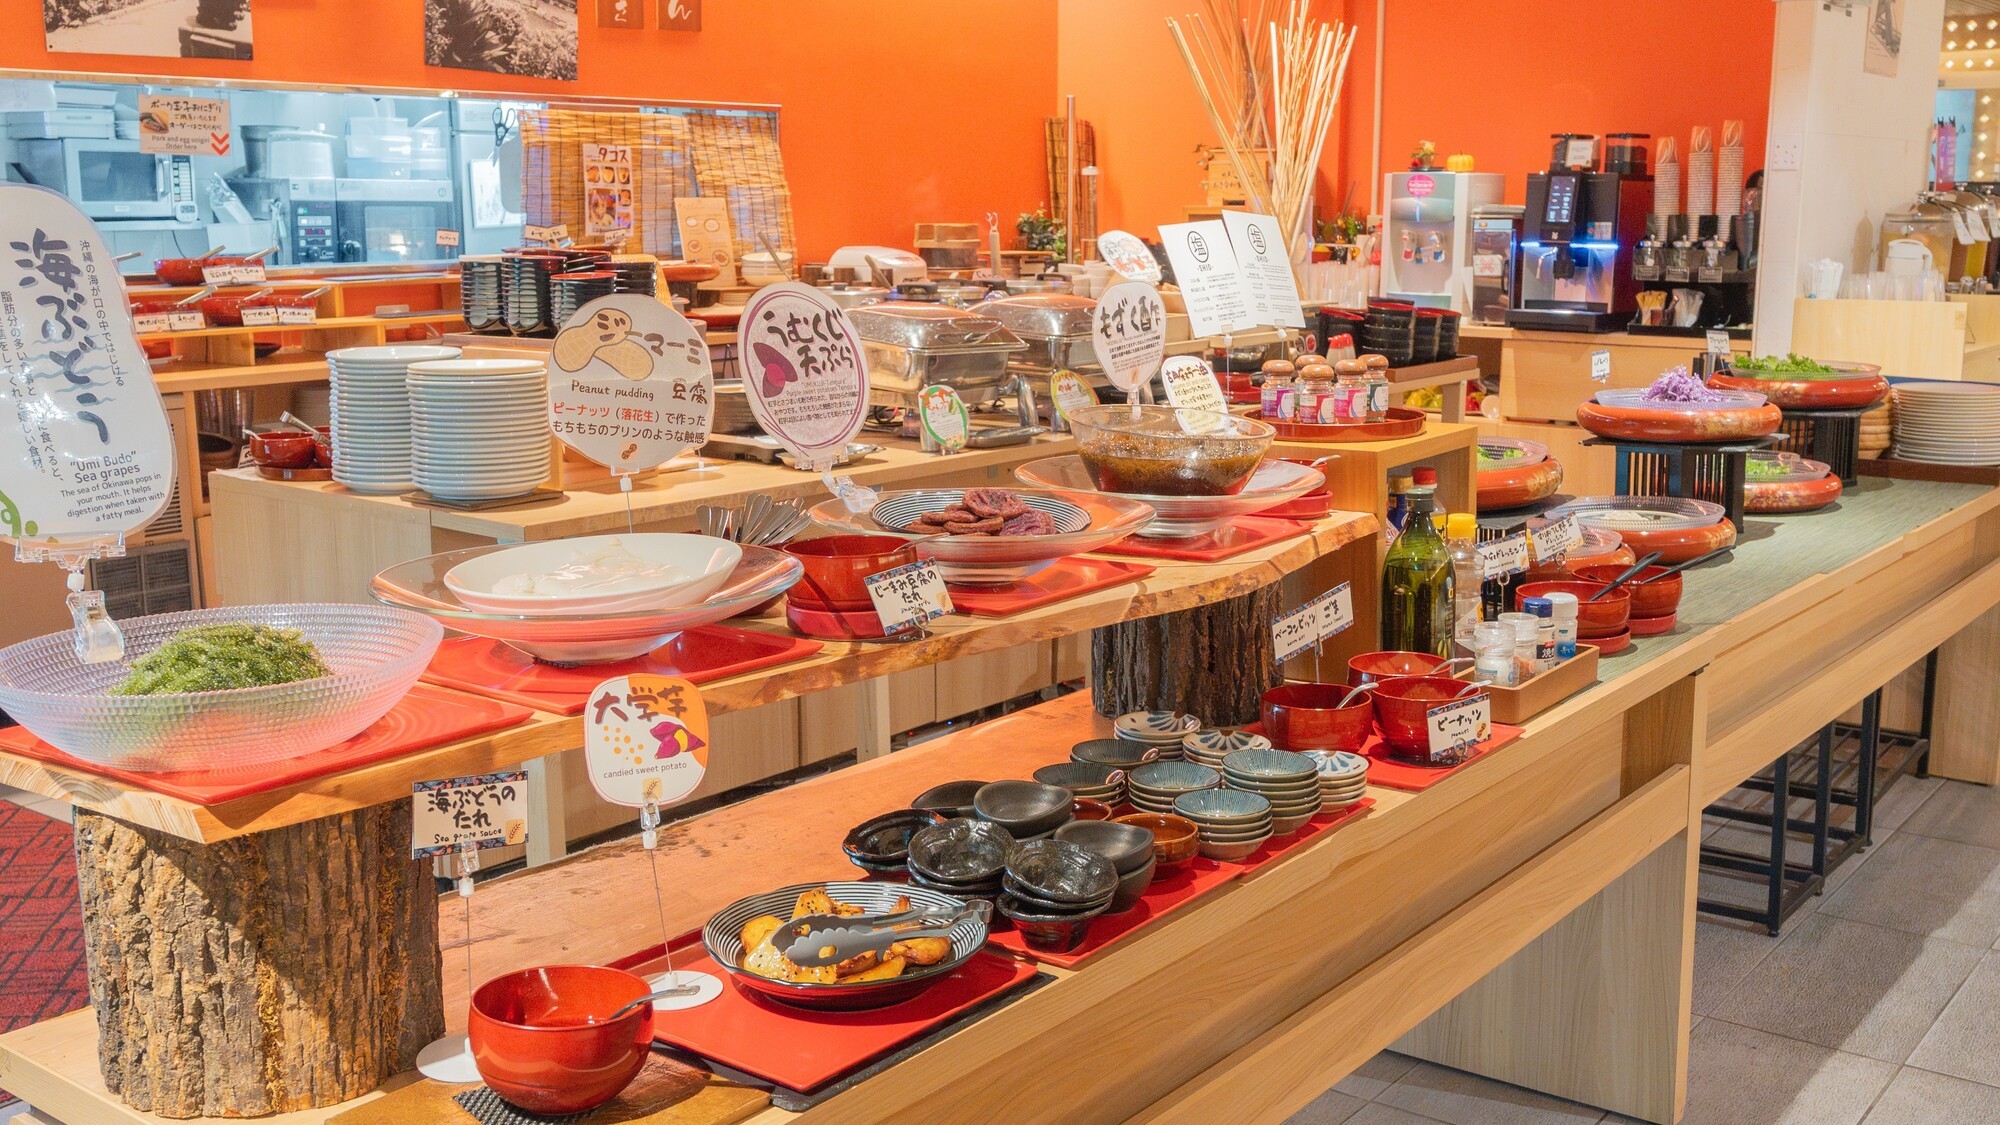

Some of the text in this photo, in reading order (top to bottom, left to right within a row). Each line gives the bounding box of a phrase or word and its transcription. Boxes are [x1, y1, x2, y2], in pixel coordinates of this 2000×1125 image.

[599, 147, 629, 163] タコス
[763, 308, 843, 347] うむくじ
[1100, 296, 1161, 339] もずく酢
[10, 228, 108, 443] 海ぶどう
[797, 344, 853, 377] 天ぷら
[571, 380, 654, 401] Peanut pudding
[672, 378, 708, 405] 豆腐
[552, 420, 705, 444] もちもちのプリンのような触感
[60, 489, 76, 498] The
[92, 484, 100, 493] of
[101, 479, 134, 490] Okinawa
[135, 475, 152, 487] pops
[154, 472, 161, 480] in
[75, 464, 140, 483] Sea grapes
[67, 491, 165, 518] digestion when taken with
[77, 485, 152, 506] your mouth. It helps
[102, 510, 123, 521] fatty
[124, 506, 144, 517] meal.
[875, 570, 936, 598] じーまみ豆腐の
[902, 591, 922, 603] たれ
[1324, 599, 1339, 618] ごま
[593, 685, 688, 724] 大学芋
[1438, 709, 1481, 732] ピーナッツ
[603, 762, 687, 779] candied sweet potato
[427, 785, 516, 814] 海ぶどうの
[453, 809, 492, 829] たれ
[434, 833, 449, 844] Sea
